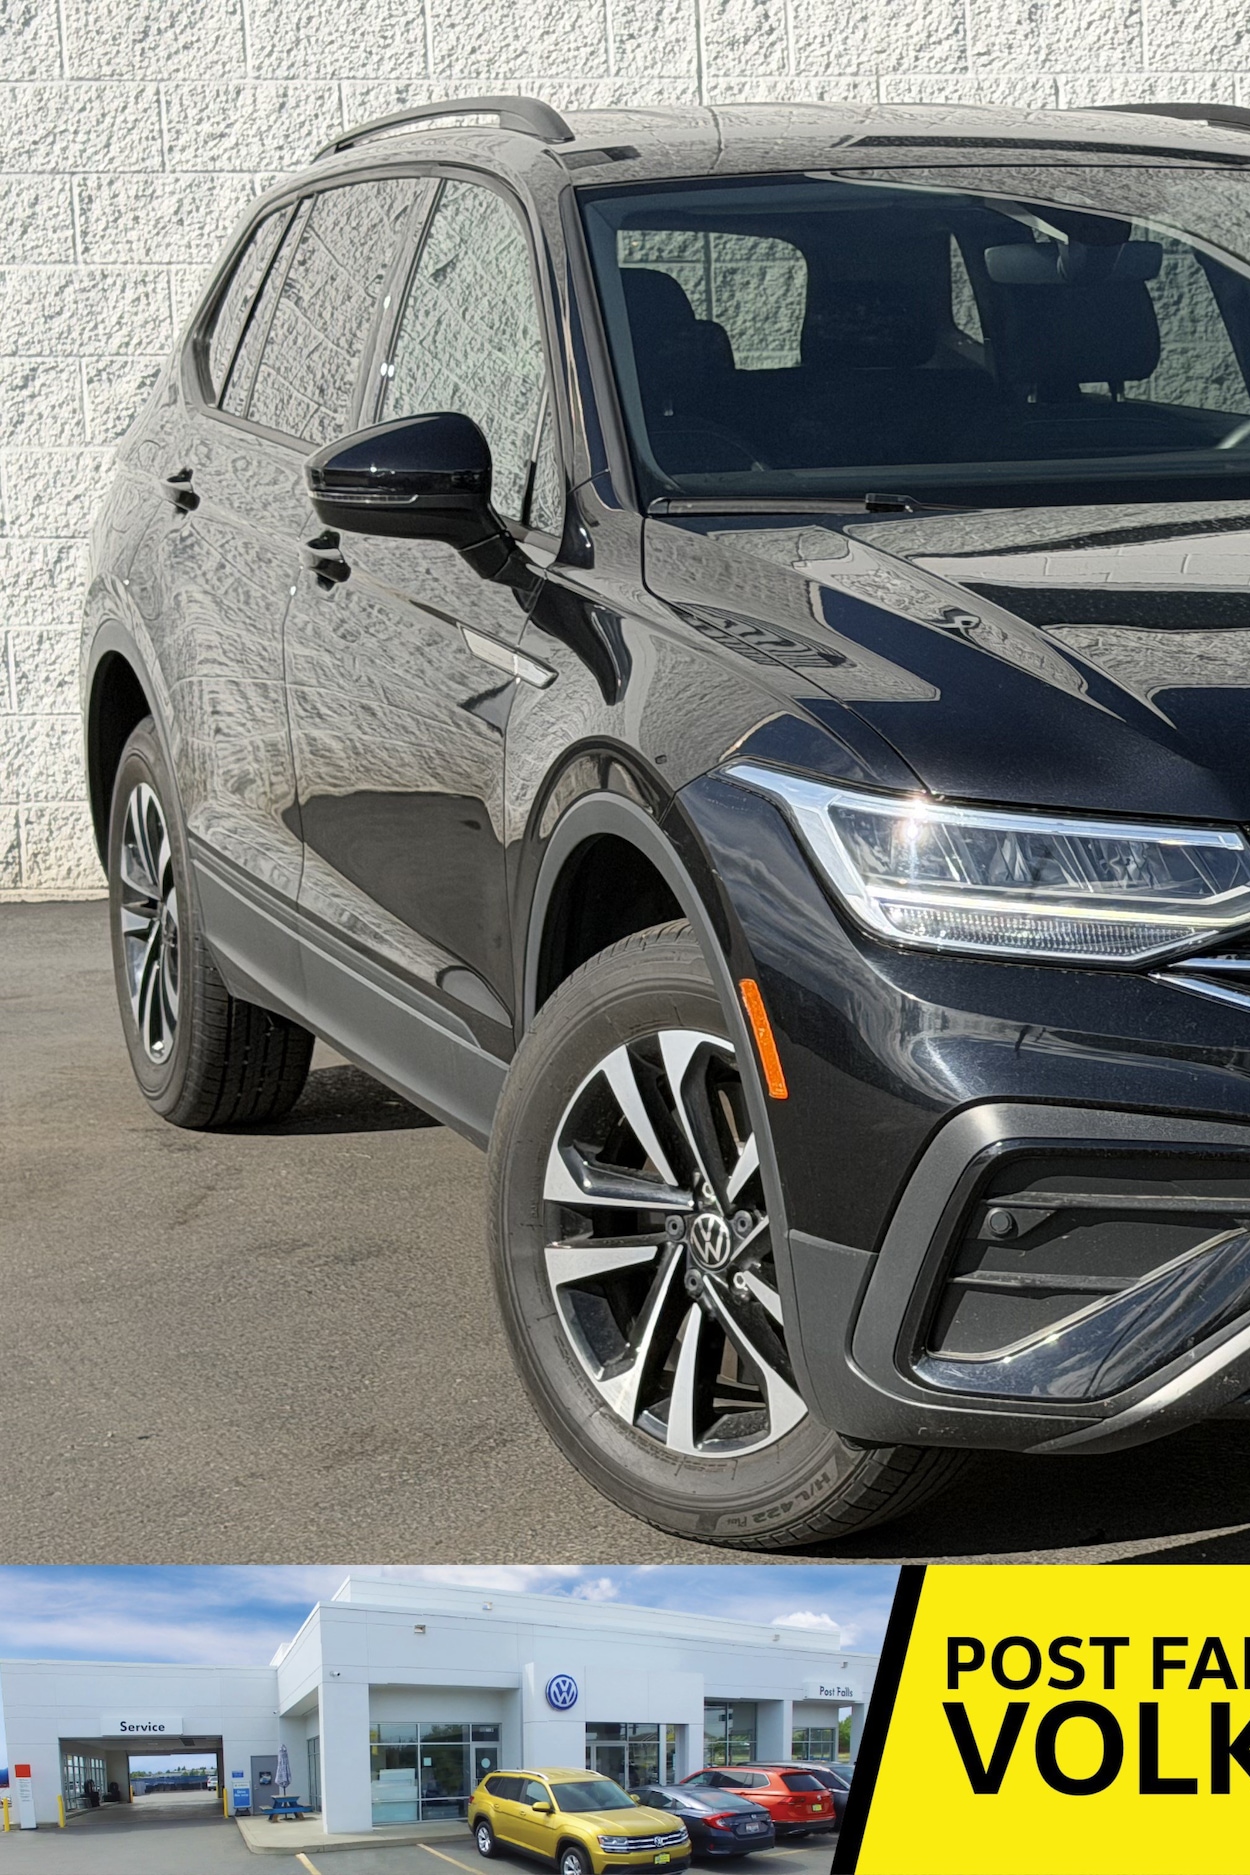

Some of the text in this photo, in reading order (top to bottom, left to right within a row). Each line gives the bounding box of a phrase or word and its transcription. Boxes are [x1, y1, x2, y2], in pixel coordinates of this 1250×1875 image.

[691, 1213, 730, 1268] VW
[549, 1675, 577, 1709] VW
[819, 1685, 853, 1697] Post Falls
[119, 1720, 165, 1733] Service
